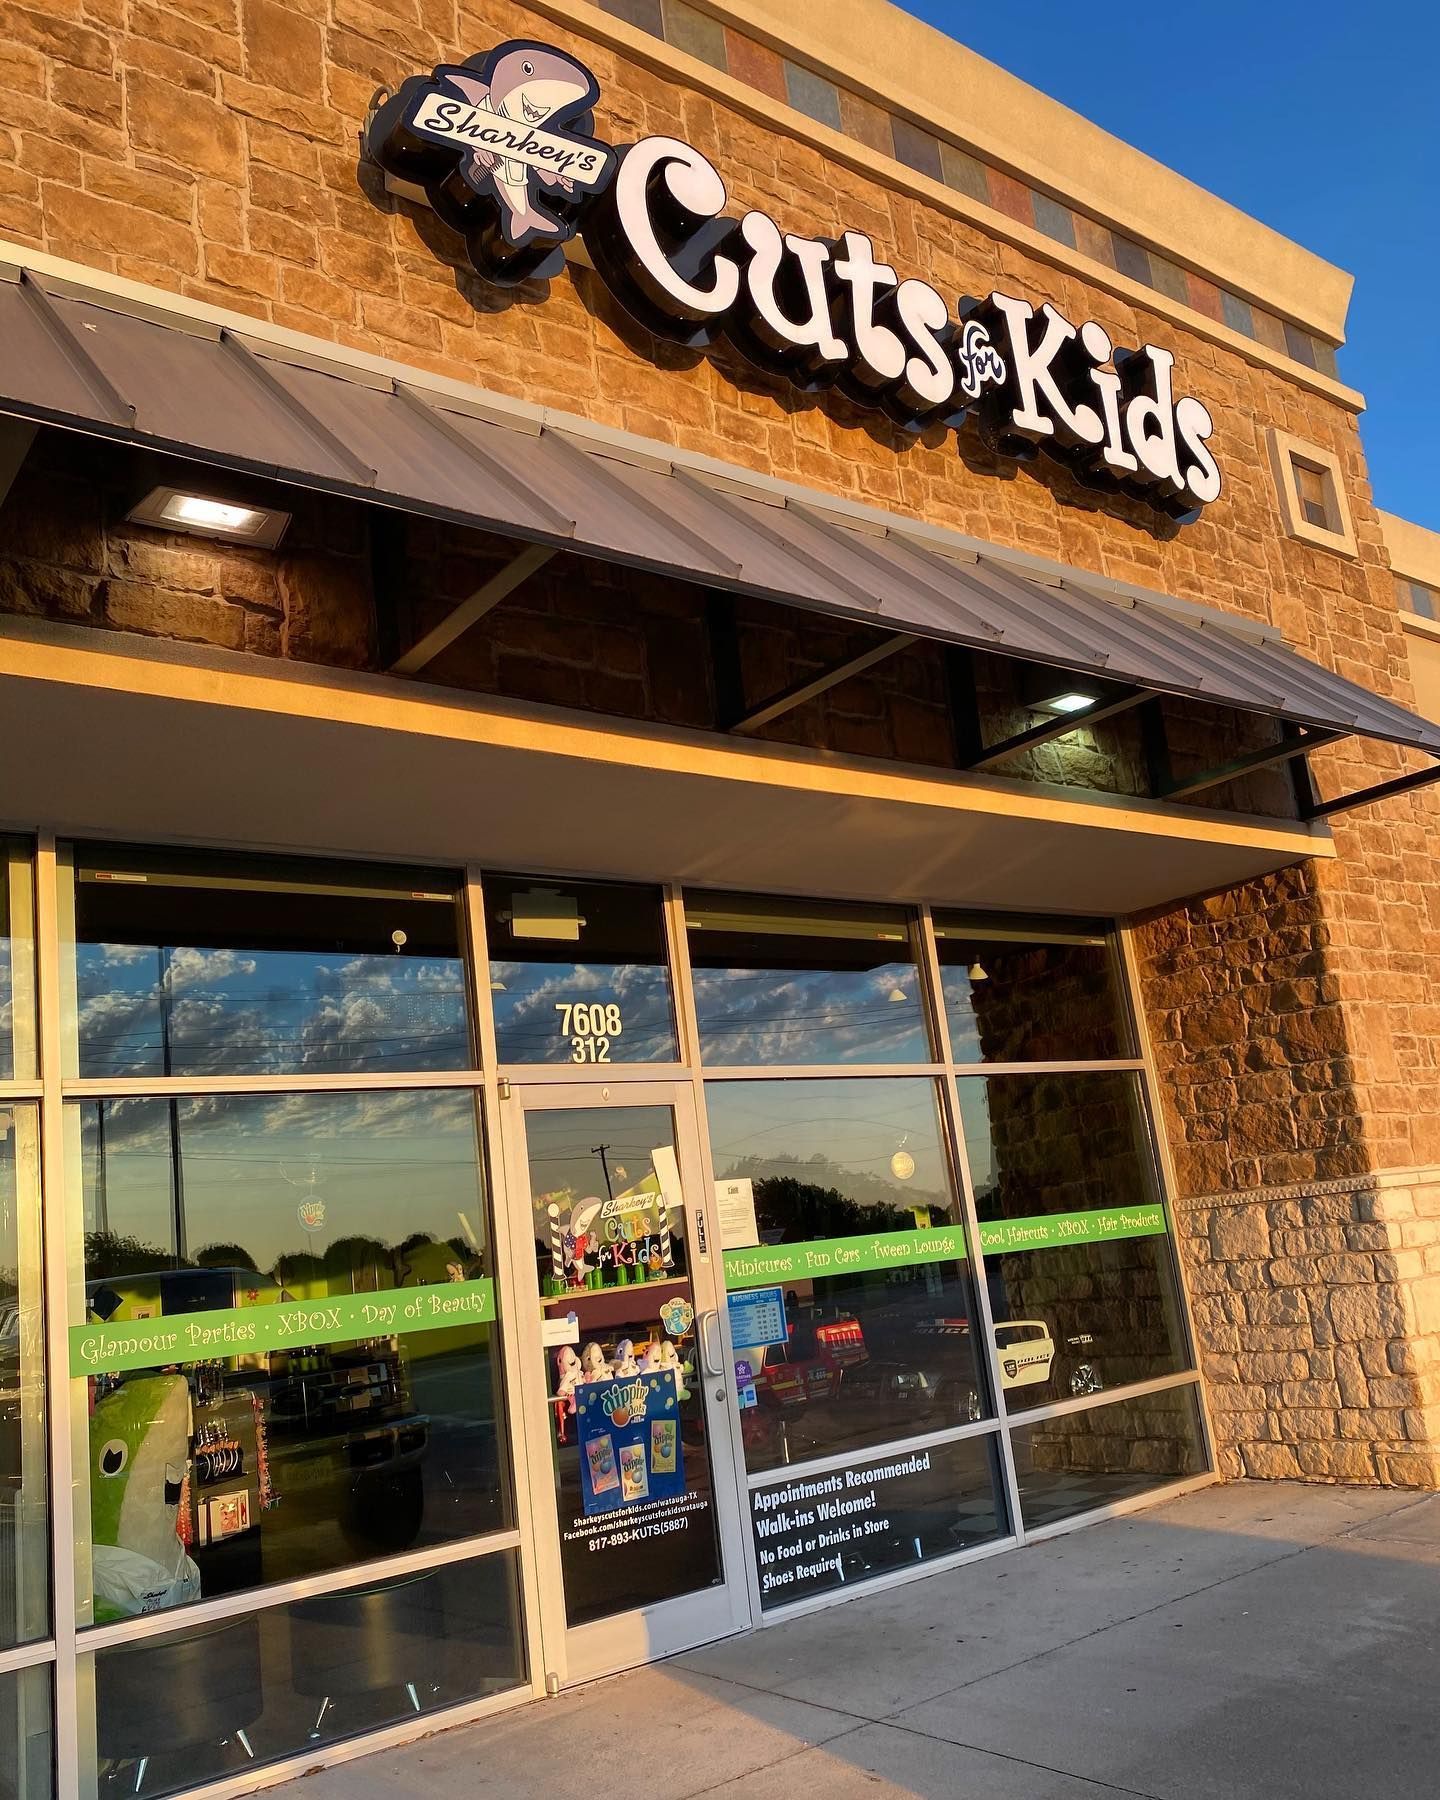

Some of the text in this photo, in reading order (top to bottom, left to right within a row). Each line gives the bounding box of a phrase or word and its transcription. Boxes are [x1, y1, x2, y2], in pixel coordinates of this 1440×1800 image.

[424, 103, 597, 172] Sharkey's
[616, 135, 1221, 503] Cuts for Kids
[555, 1003, 622, 1036] 7608
[571, 1036, 611, 1063] 312
[602, 1195, 654, 1216] Sharkey's
[604, 1215, 652, 1243] Cuts
[696, 1211, 705, 1243] PULL
[980, 1212, 1160, 1247] Cool Haircuts XBOX Hair Products
[597, 1236, 661, 1269] for Kids
[725, 1237, 956, 1278] Minicures Fun Cars Tween Lounge
[80, 1292, 486, 1365] Glamour Parties XBOX Day of Beauty
[754, 1452, 931, 1512] Appointments Recommended
[563, 1500, 708, 1541] Facebook.com/sharkeyscutsforkidswatauga
[756, 1489, 877, 1538] Walk-ins Welcome!
[588, 1516, 689, 1552] 817-893-KUTS(5887)
[760, 1517, 890, 1565] No Food or Drinks in Store
[762, 1552, 843, 1590] Shoes Required
